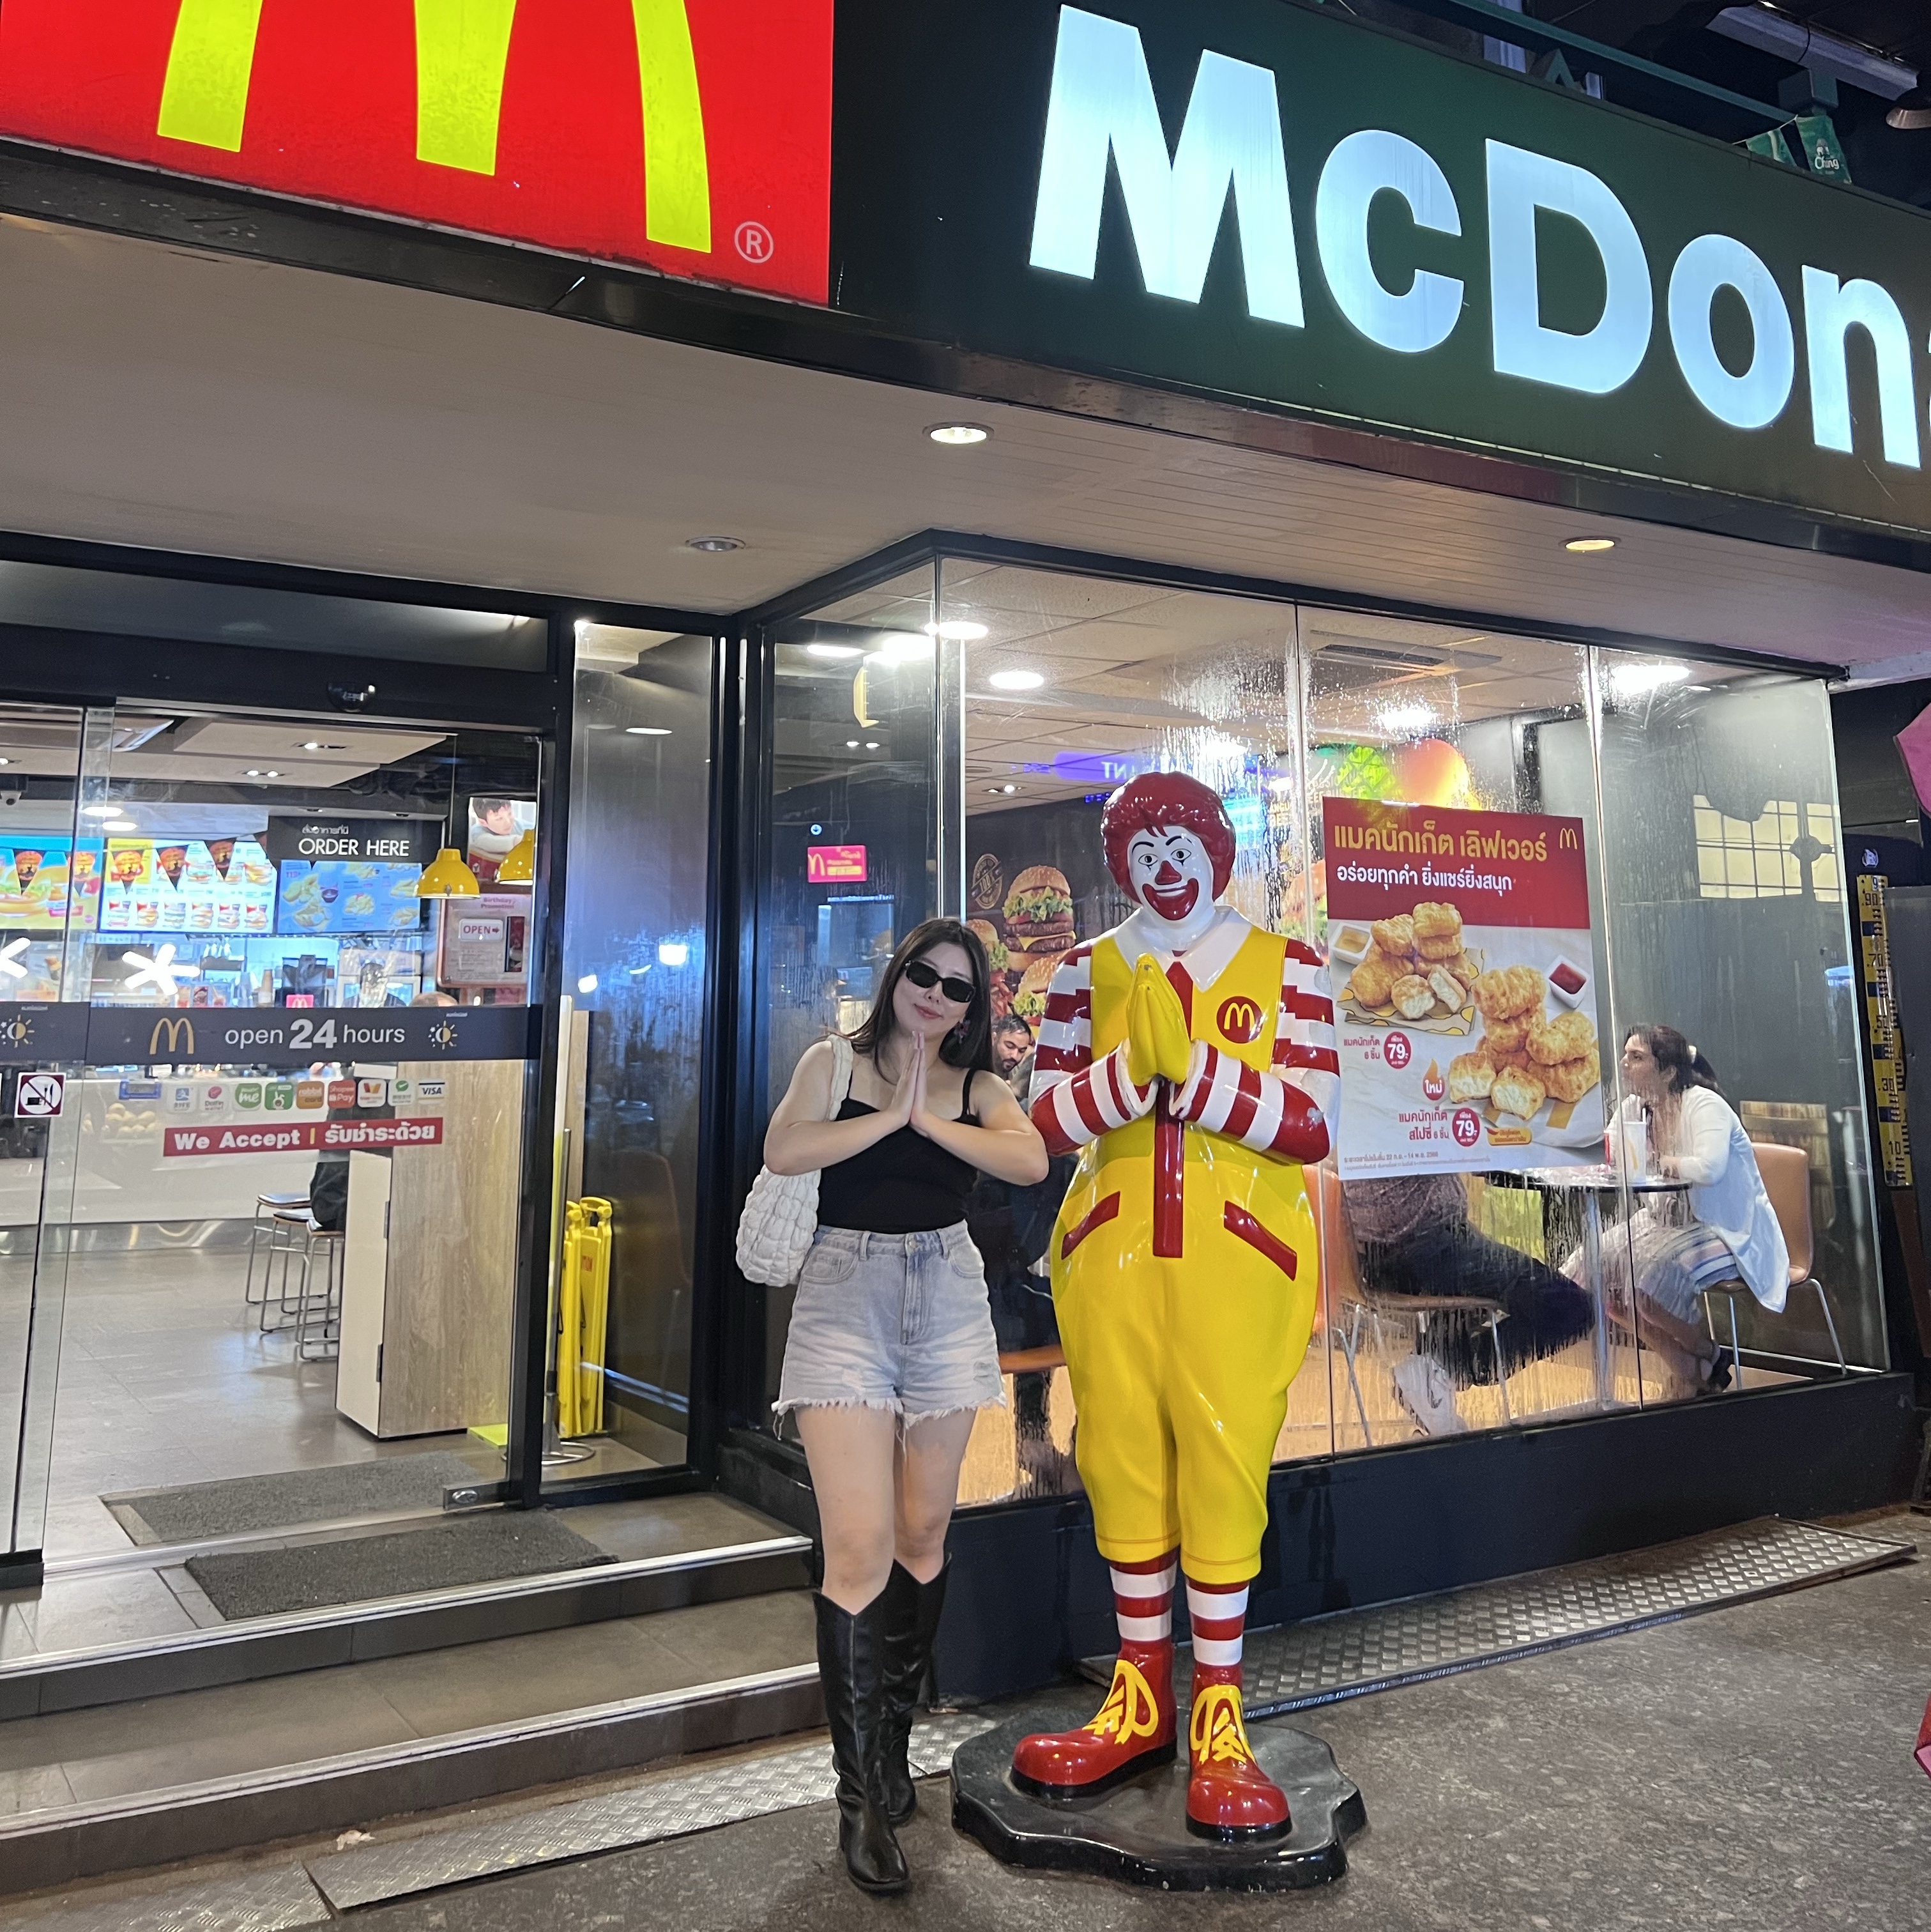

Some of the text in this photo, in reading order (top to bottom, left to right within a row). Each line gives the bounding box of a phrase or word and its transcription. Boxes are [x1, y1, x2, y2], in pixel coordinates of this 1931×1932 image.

[1029, 4, 1931, 469] McDon
[298, 838, 410, 857] ORDER HERE
[1334, 820, 1548, 862] แมคนักเก็ต เลิฟเวอร์
[1336, 861, 1513, 897] อร่อยทุกคำ ยิ่งแชร์ยิ่งสนุก
[463, 925, 491, 934] OPEN
[224, 1018, 406, 1049] open 24 hours
[422, 1087, 443, 1096] VISA
[1424, 1079, 1442, 1094] ใหม่
[174, 1130, 300, 1150] We Accept
[324, 1122, 436, 1144] รับชำระด้วย
